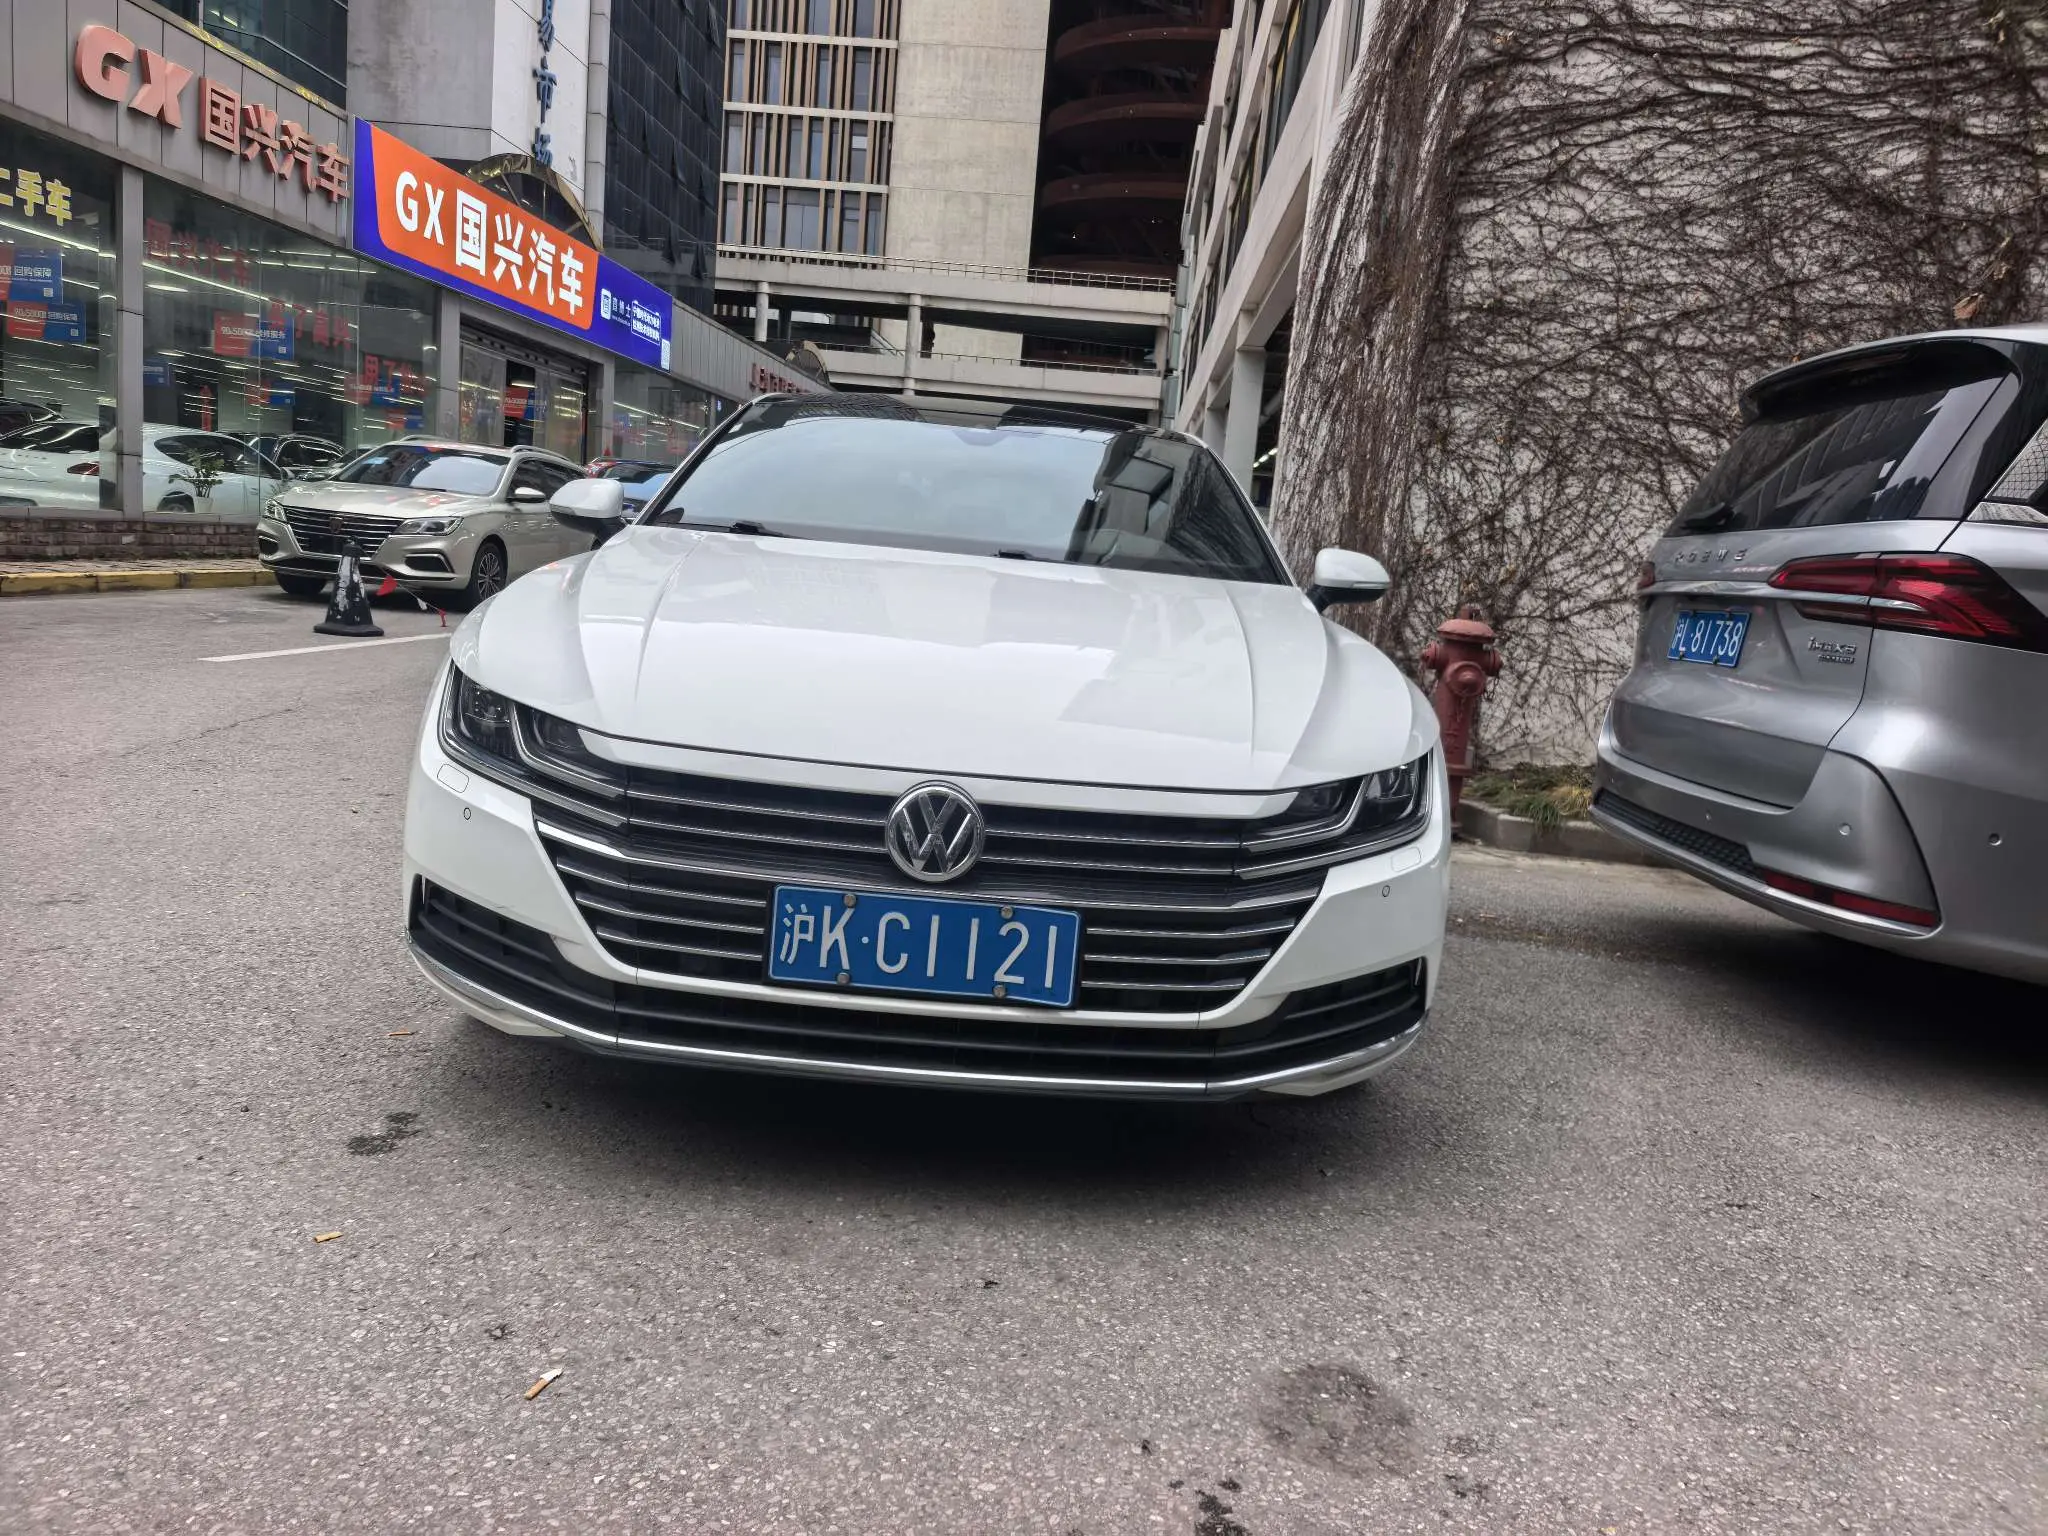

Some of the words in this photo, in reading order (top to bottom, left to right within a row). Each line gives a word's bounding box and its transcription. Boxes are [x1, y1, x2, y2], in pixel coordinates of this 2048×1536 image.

[75, 25, 194, 129] GX
[199, 77, 350, 203] 国兴汽车
[395, 171, 445, 246] GX
[456, 188, 585, 316] 国兴汽车
